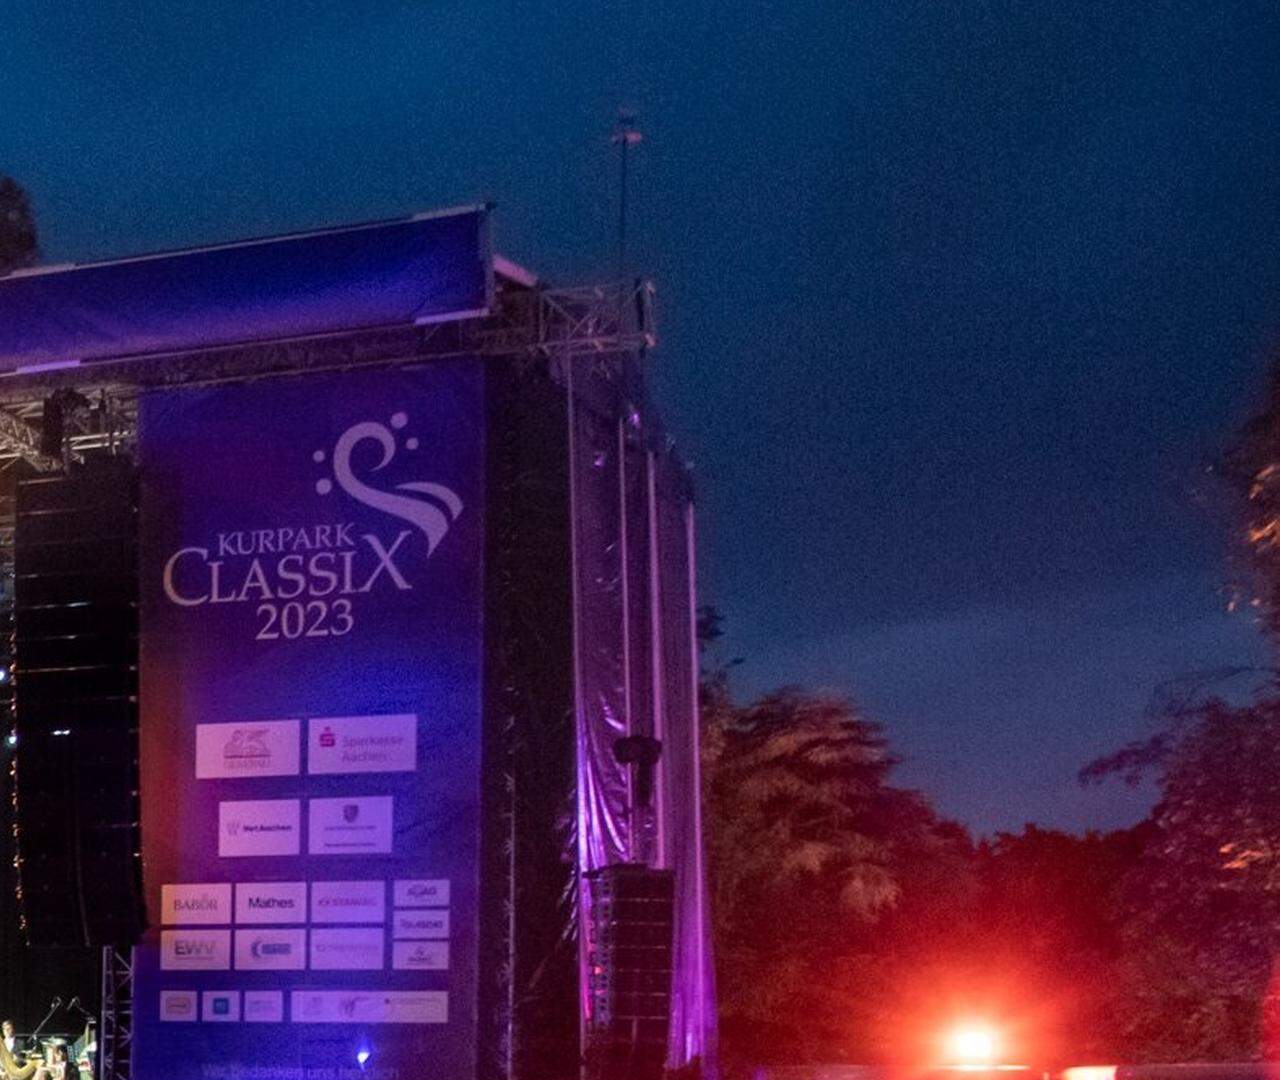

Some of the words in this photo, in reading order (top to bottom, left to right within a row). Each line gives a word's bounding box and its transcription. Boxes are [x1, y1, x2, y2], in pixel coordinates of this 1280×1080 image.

[218, 521, 356, 557] KURPARK
[162, 529, 413, 606] CLASSIX
[255, 599, 355, 641] 2023
[248, 897, 295, 909] Mathes
